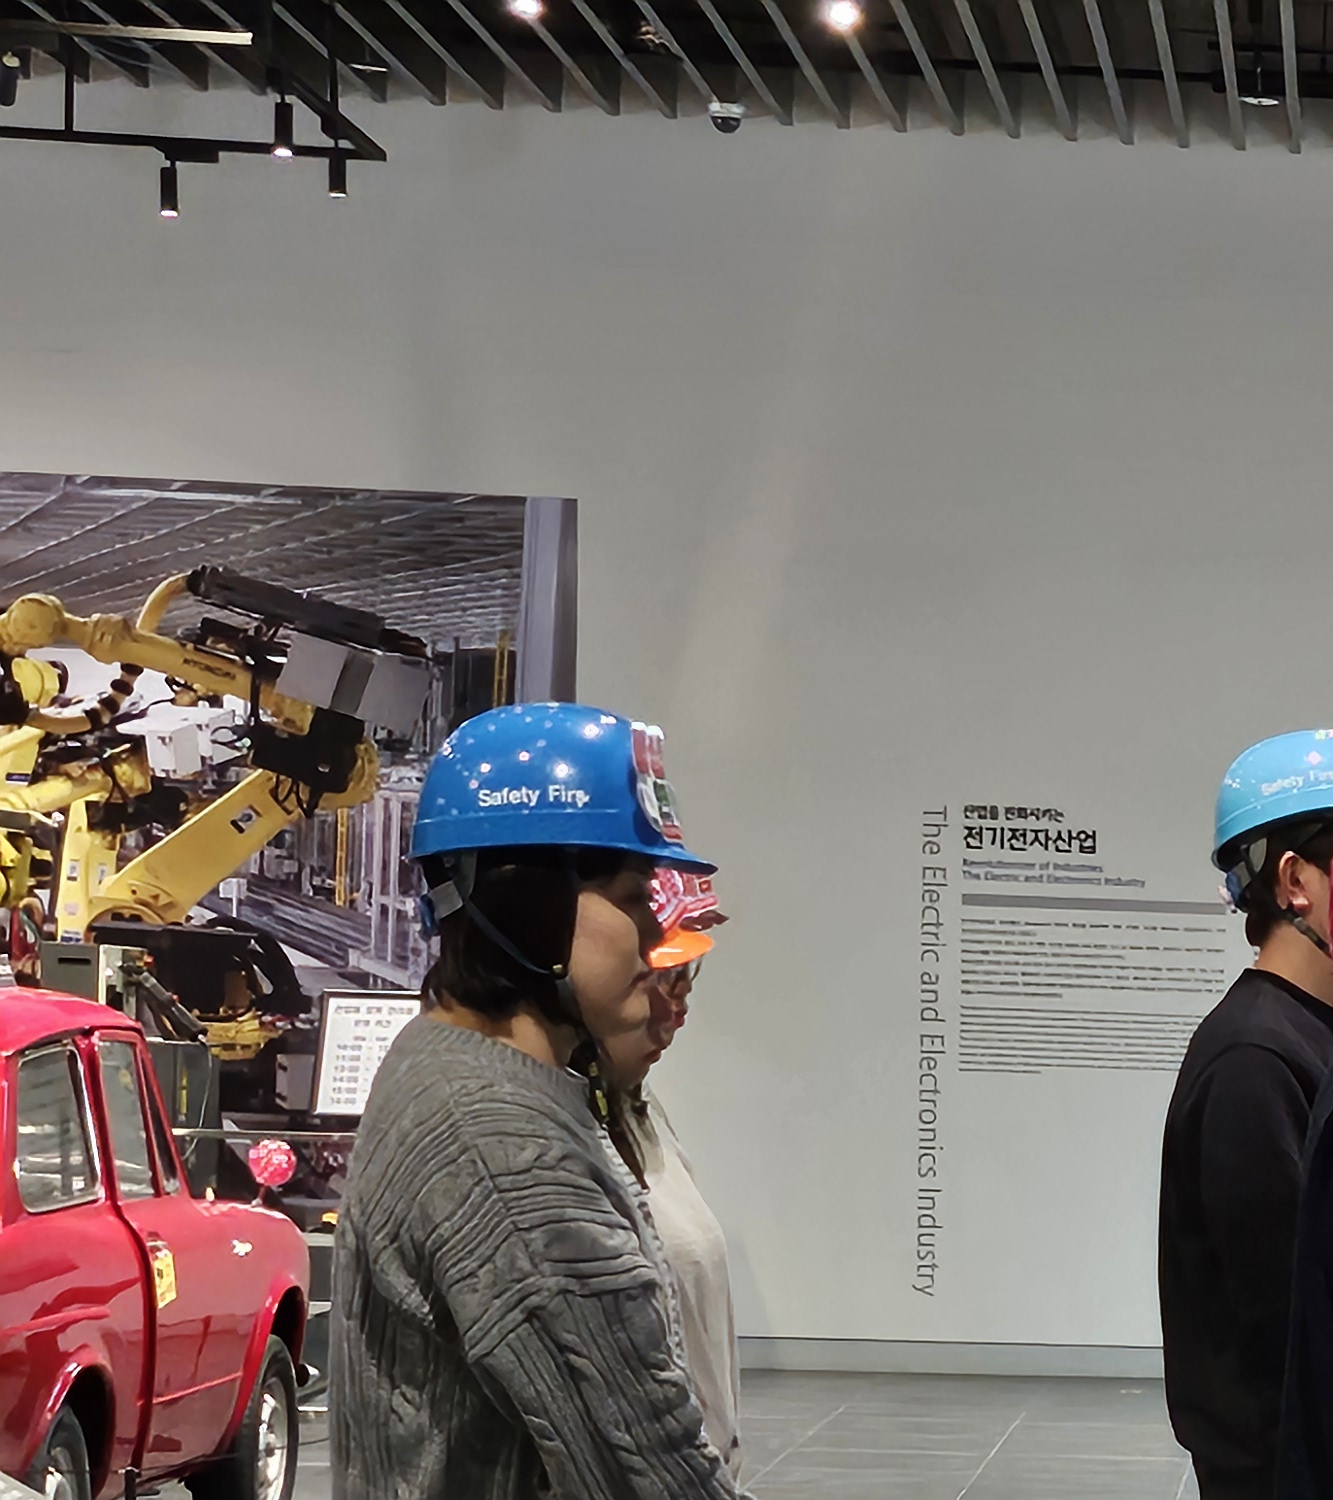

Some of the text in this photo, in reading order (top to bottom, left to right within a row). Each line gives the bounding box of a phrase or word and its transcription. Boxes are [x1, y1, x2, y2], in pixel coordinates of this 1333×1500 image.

[478, 786, 540, 807] Safety
[1261, 775, 1304, 796] Safety
[963, 825, 1097, 855] 전기전자산업
[911, 804, 949, 1298] The Electric and Electronics Industry
